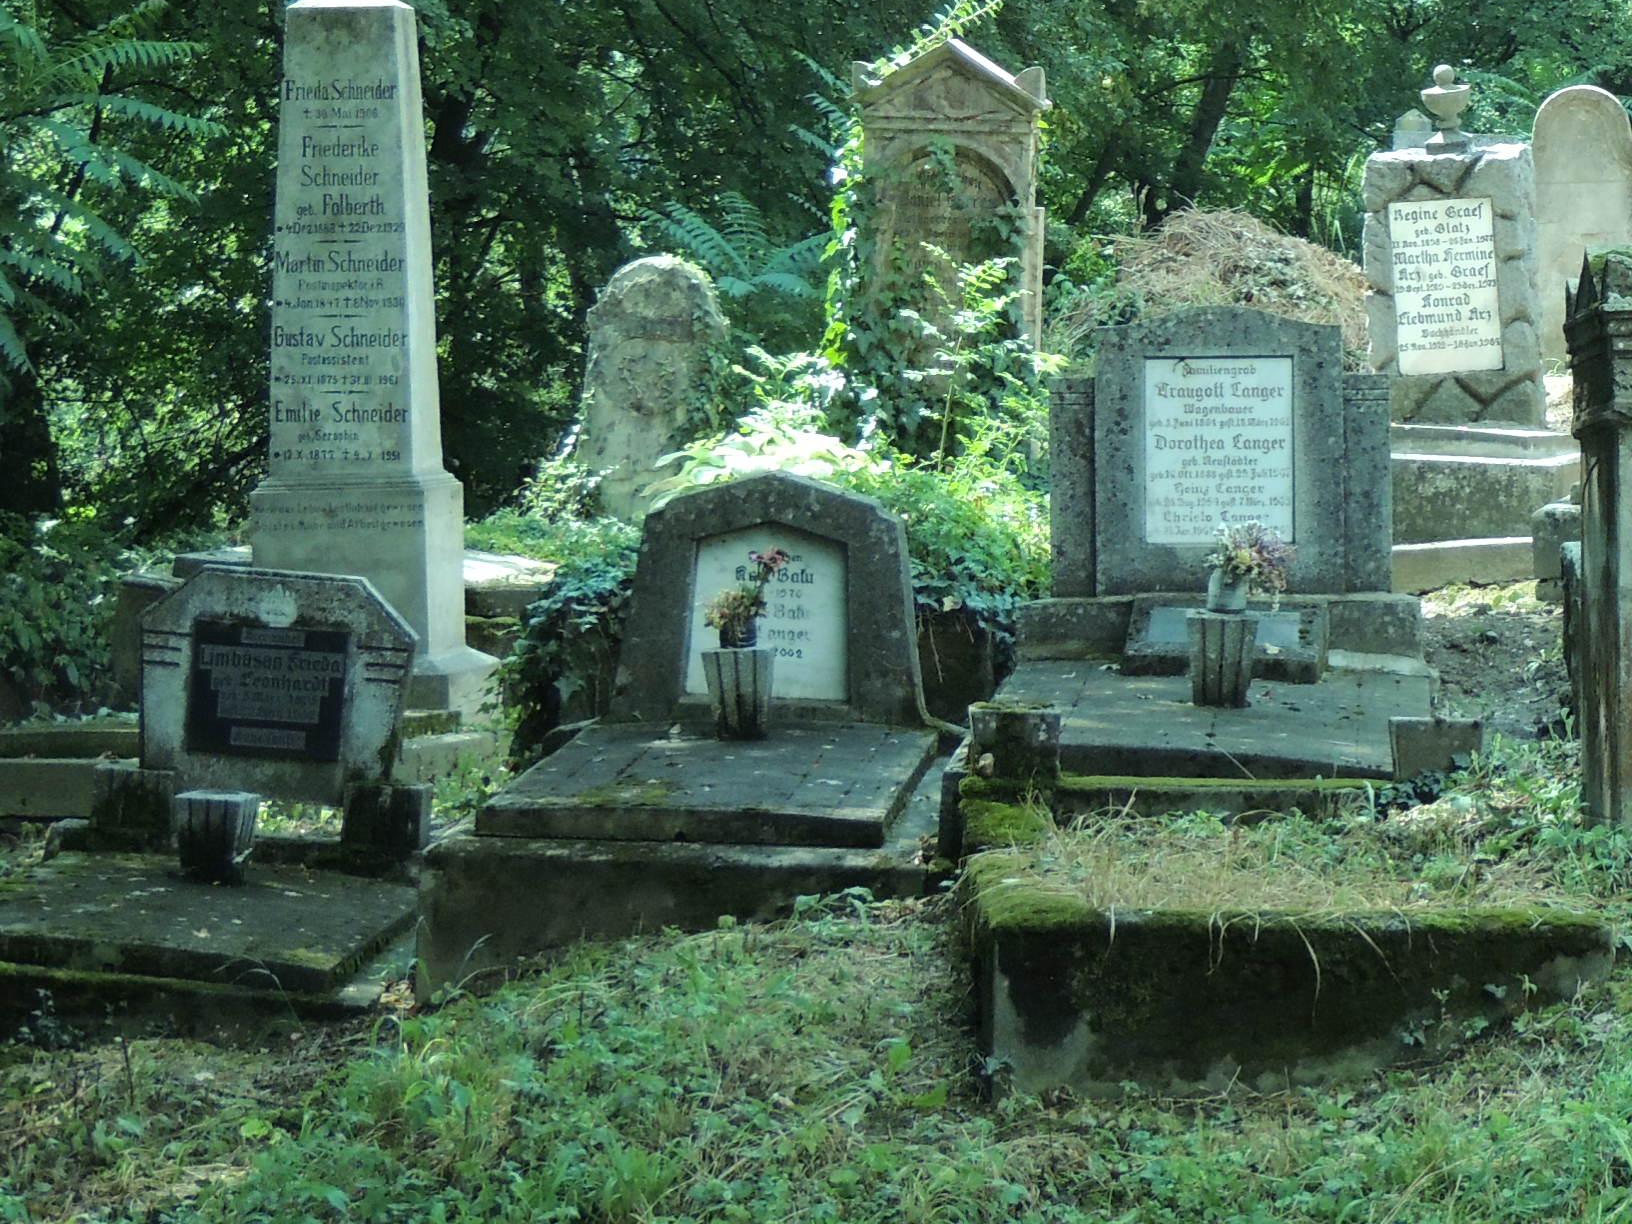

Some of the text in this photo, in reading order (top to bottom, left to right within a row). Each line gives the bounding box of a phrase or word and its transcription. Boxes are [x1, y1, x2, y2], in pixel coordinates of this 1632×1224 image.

[284, 78, 398, 102] Frieda Schneider
[302, 135, 380, 158] Friederike
[301, 163, 380, 187] Schneider
[322, 192, 386, 216] Folberth
[1393, 206, 1439, 225] Regine
[1414, 222, 1470, 238] geb. Glatz
[274, 249, 406, 274] Martin Schneider
[1393, 247, 1495, 267] Martha Hermine
[1398, 267, 1421, 282] Arz
[1421, 292, 1471, 309] Konrad
[1468, 306, 1492, 322] Arz
[273, 325, 409, 348] Gustav Schneider
[1182, 363, 1257, 379] Familiengrab
[1154, 381, 1285, 402] Traugott Langer
[274, 400, 409, 424] Emilie Schneider
[1183, 403, 1255, 417] Wagenbauer
[1153, 434, 1286, 454] Dorothea Langer
[1215, 482, 1265, 496] Langer
